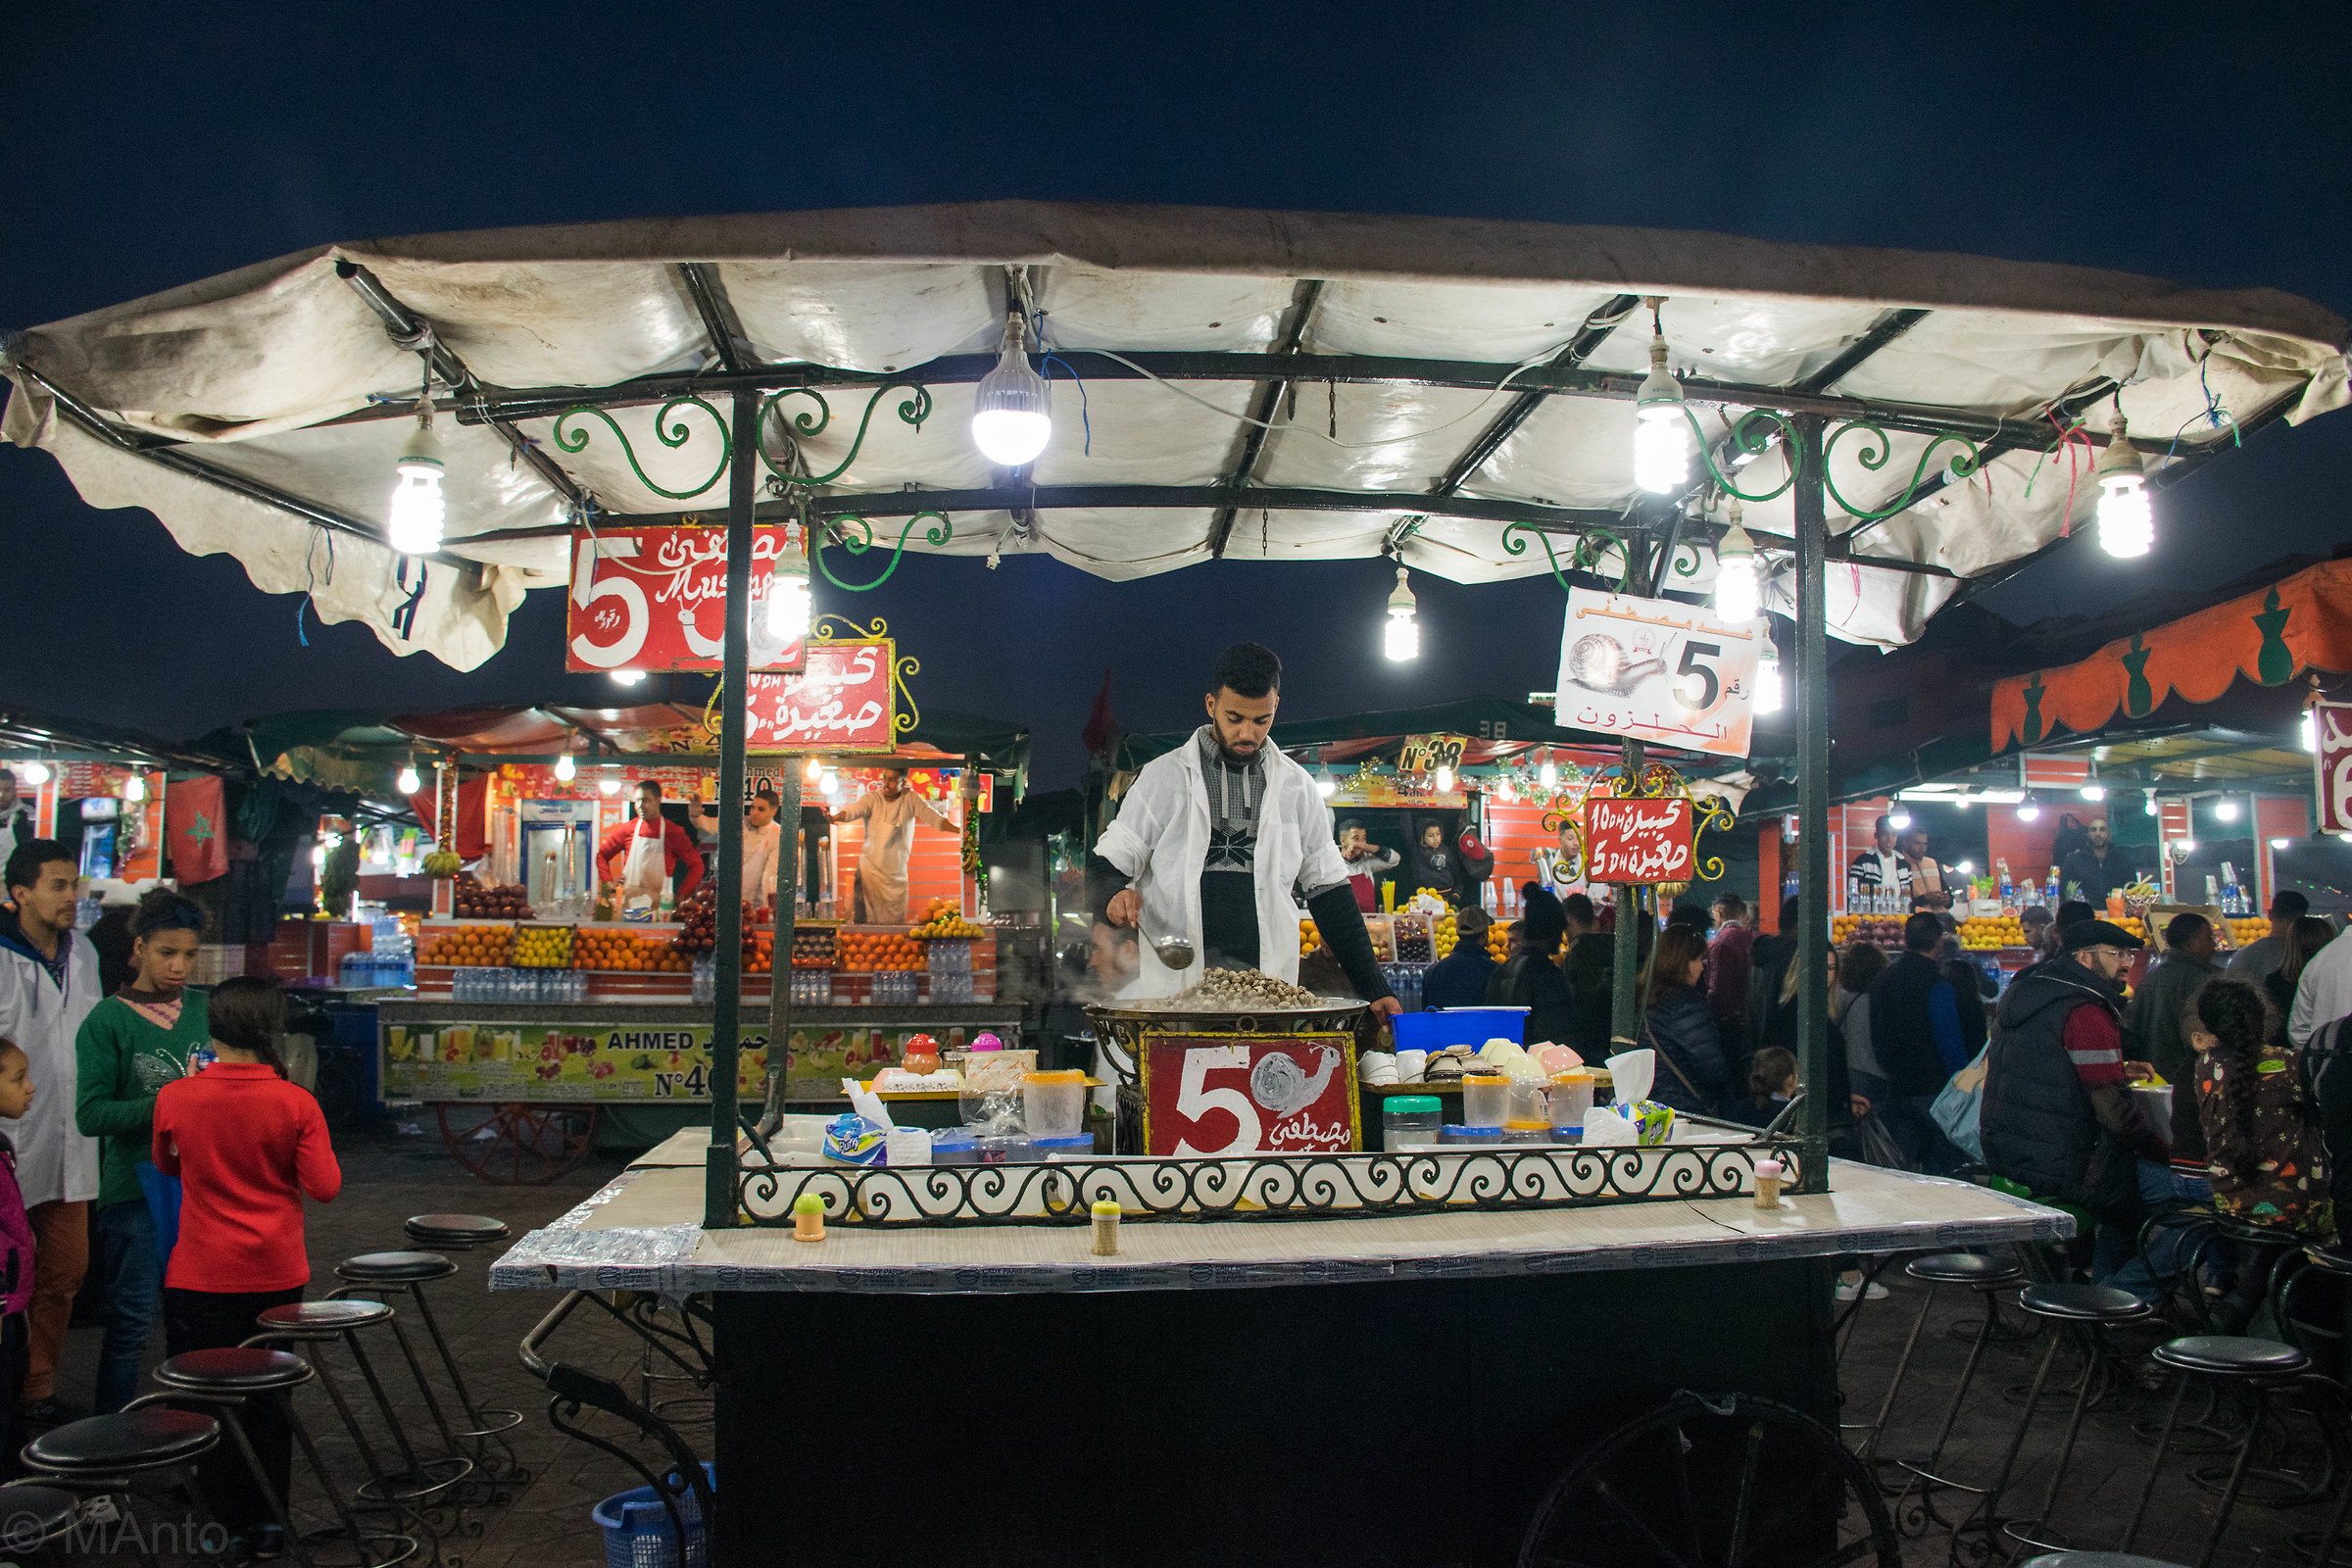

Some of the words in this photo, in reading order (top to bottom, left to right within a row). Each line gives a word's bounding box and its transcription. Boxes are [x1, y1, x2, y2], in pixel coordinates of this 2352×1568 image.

[571, 536, 649, 668] 5
[1576, 598, 1693, 632] مصطفى
[1672, 640, 1721, 711] 5
[1724, 678, 1749, 700] رقم
[1479, 719, 1507, 739] 38
[1576, 706, 1729, 742] الحلزون
[1620, 799, 1683, 843] كبيرة
[1628, 833, 1689, 878] صغيرة
[607, 1032, 694, 1051] AHMED
[654, 1065, 713, 1097] N°4
[1171, 1045, 1263, 1156] 5
[1268, 1111, 1351, 1146] مصطفى
